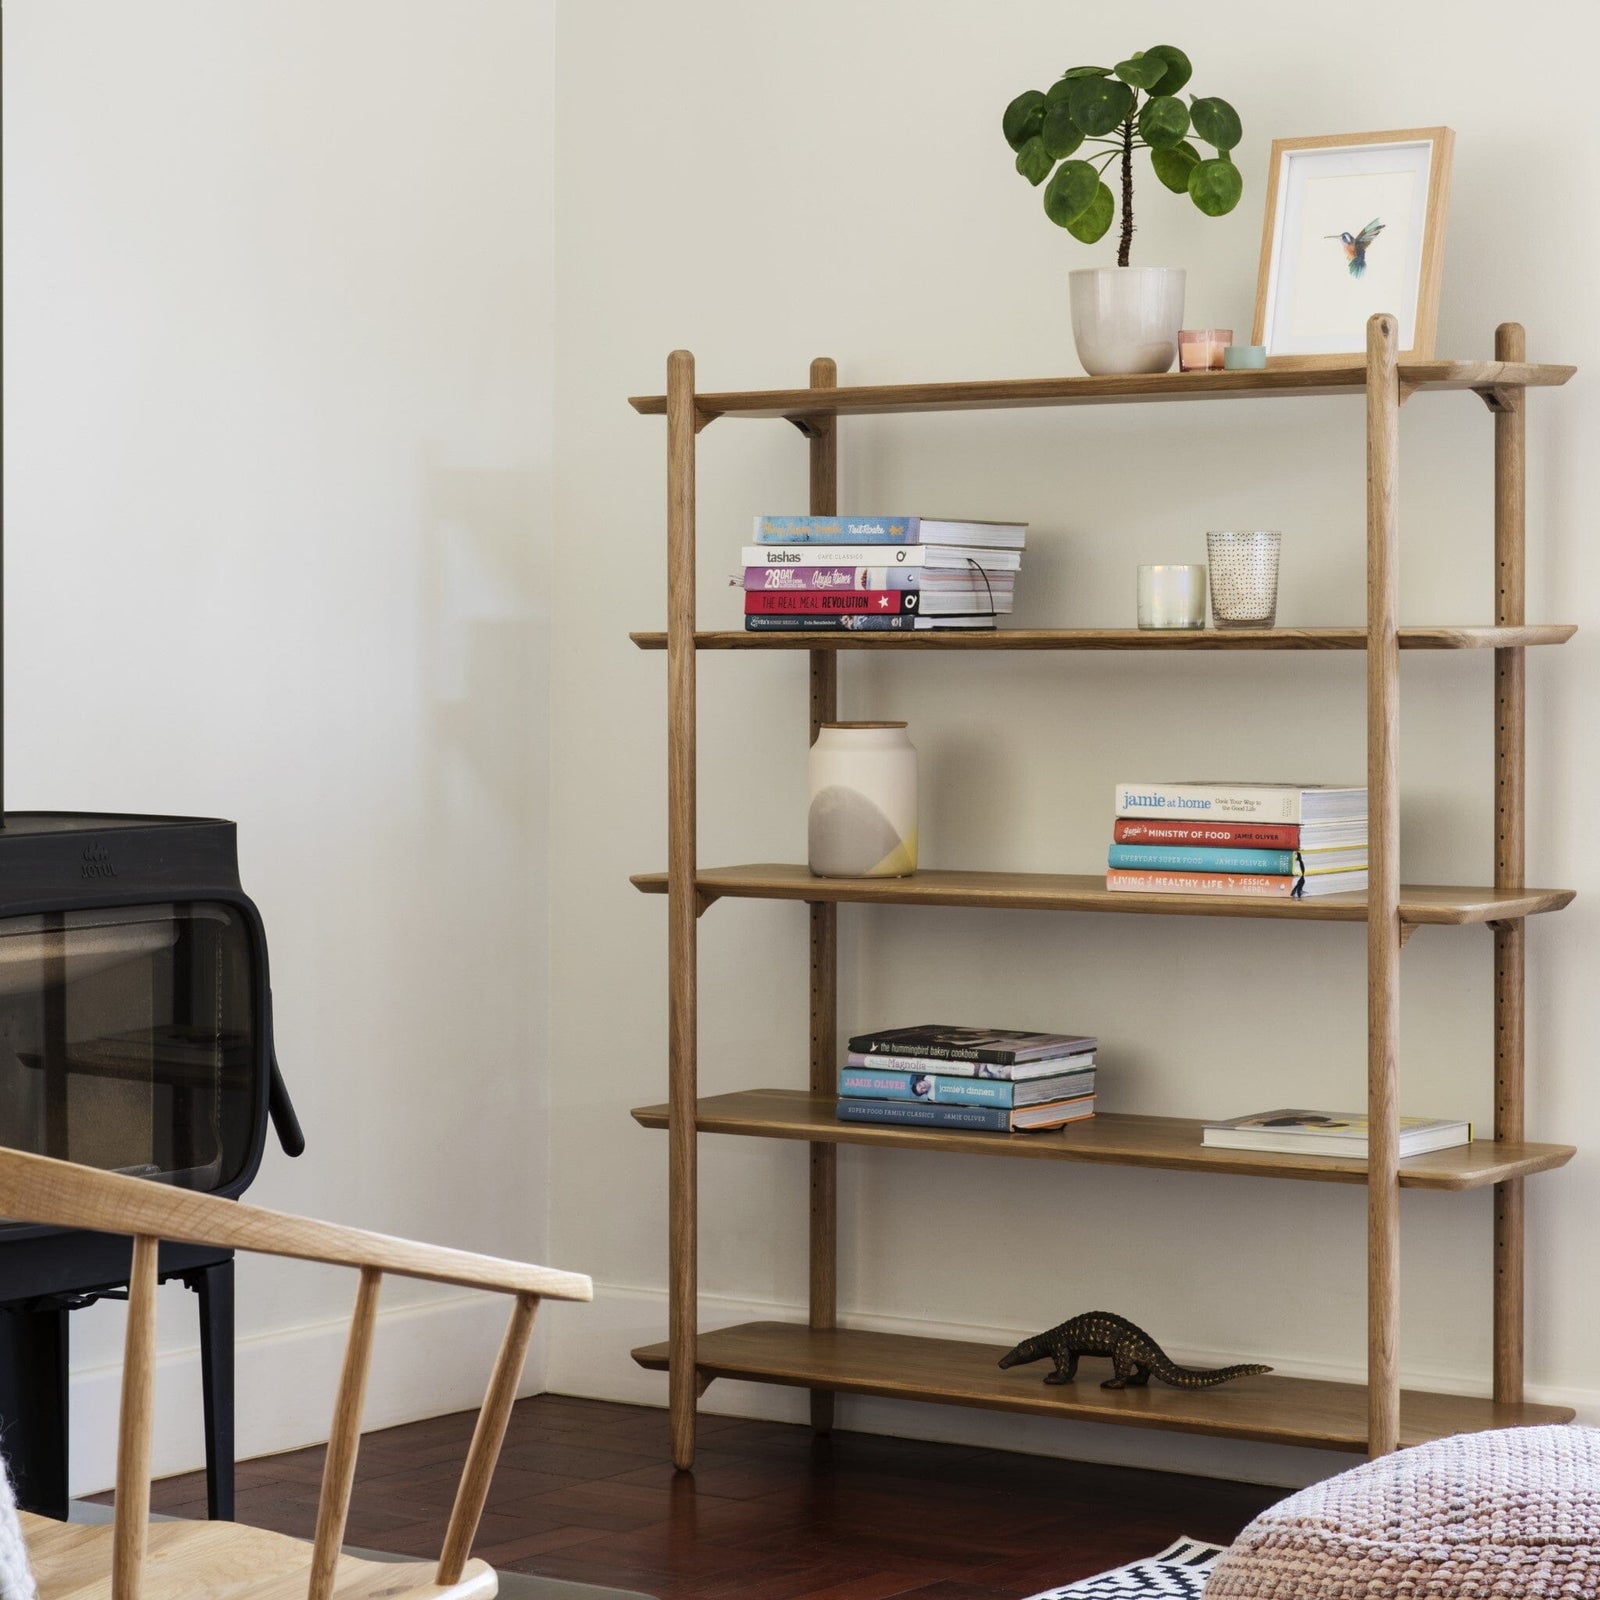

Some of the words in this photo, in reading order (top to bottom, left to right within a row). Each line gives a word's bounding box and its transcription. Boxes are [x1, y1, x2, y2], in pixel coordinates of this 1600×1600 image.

[767, 551, 801, 563] tashas
[764, 569, 780, 588] 28
[780, 569, 794, 580] DAY
[763, 596, 775, 608] THE
[778, 596, 797, 608] REAL
[800, 596, 819, 608] MEAL
[822, 597, 869, 608] REVOLUTION
[1123, 792, 1166, 809] jamie
[1178, 797, 1212, 809] home
[1149, 829, 1189, 838] MINISTRY
[1190, 831, 1203, 839] OF
[1205, 831, 1231, 840] FOOD
[1120, 855, 1158, 863] EVERYDAY
[1182, 857, 1203, 865] FOOD
[1215, 858, 1238, 866] JAMIE
[1239, 859, 1267, 867] OLIVER
[1113, 876, 1145, 885] LIVING
[1155, 877, 1198, 888] HEALTHY
[1202, 880, 1223, 889] LIFE
[1239, 878, 1270, 886] JESSICA
[880, 1042, 890, 1052] the
[891, 1043, 929, 1056] hummingbird
[930, 1046, 950, 1058] bakery
[951, 1049, 979, 1059] cookbook
[887, 1058, 927, 1071] Magnolia
[845, 1077, 872, 1088] JAMIE
[873, 1079, 906, 1090] OLIVER
[939, 1085, 965, 1094] jamie's
[966, 1086, 995, 1097] dinners
[847, 1106, 866, 1114] SUPER
[884, 1109, 906, 1117] FAMILY
[906, 1111, 935, 1119] CLASSICS
[962, 1114, 986, 1122] OLIVER
